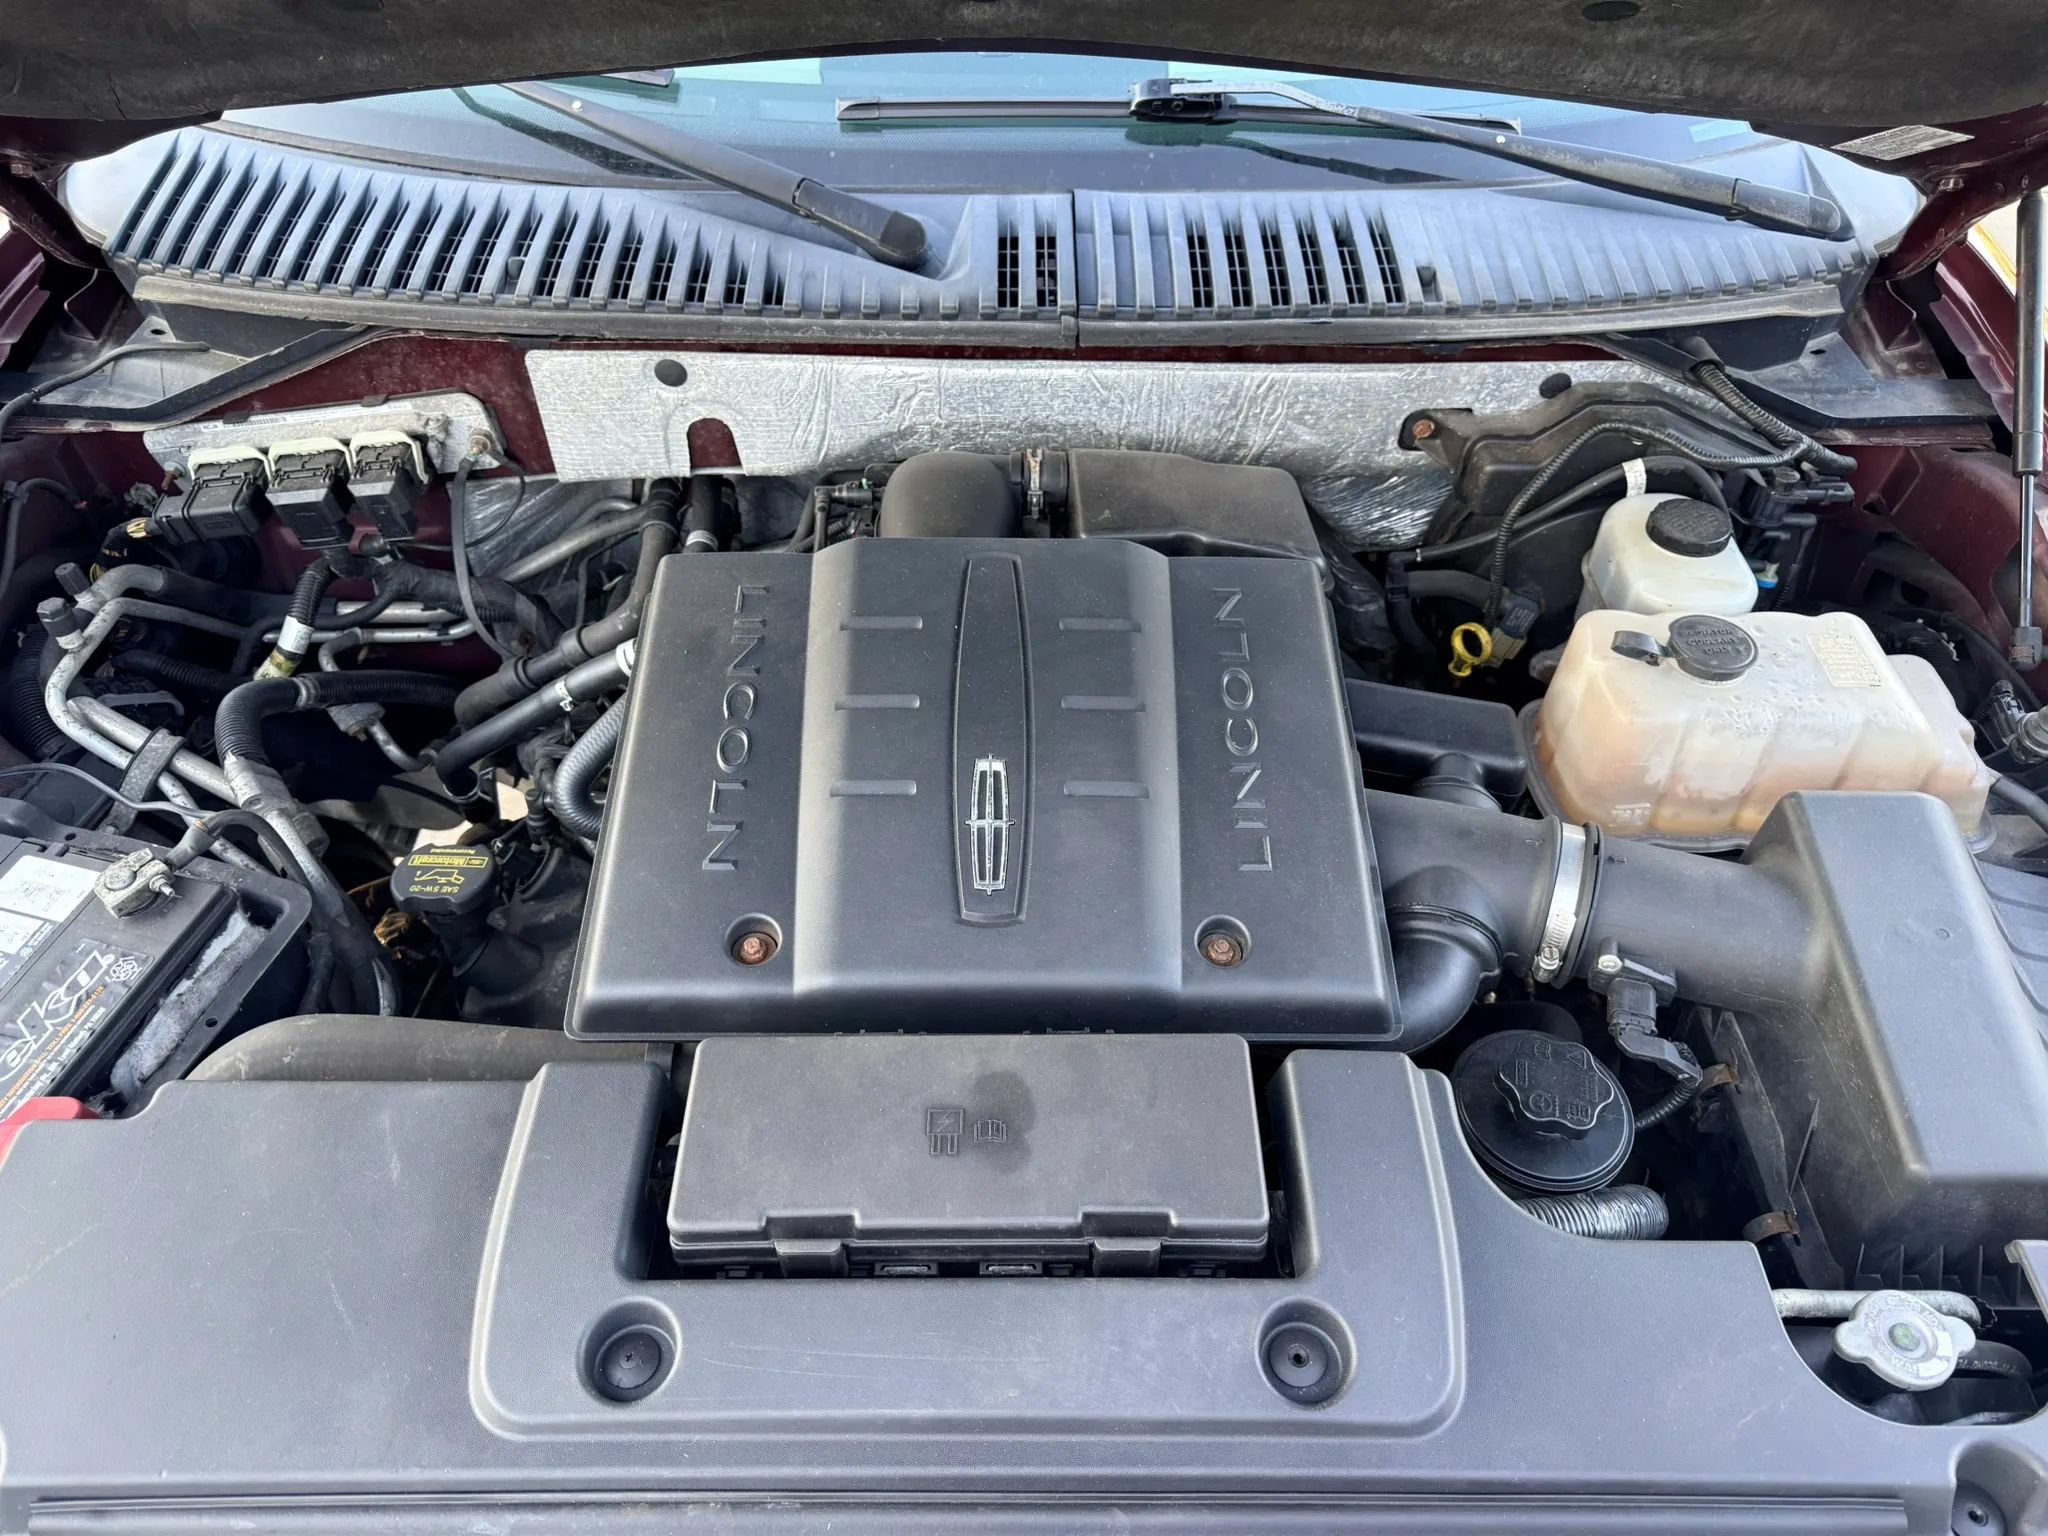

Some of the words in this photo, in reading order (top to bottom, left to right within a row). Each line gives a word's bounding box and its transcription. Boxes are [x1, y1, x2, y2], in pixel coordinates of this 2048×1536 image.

[1687, 637, 1736, 646] COOLANT
[1705, 645, 1730, 656] ONLY
[702, 585, 771, 873] LINCOLN
[1208, 586, 1272, 873] LINCOLN
[413, 856, 465, 866] Motorcraft
[409, 885, 439, 893] 5W-20
[439, 886, 460, 894] SAE
